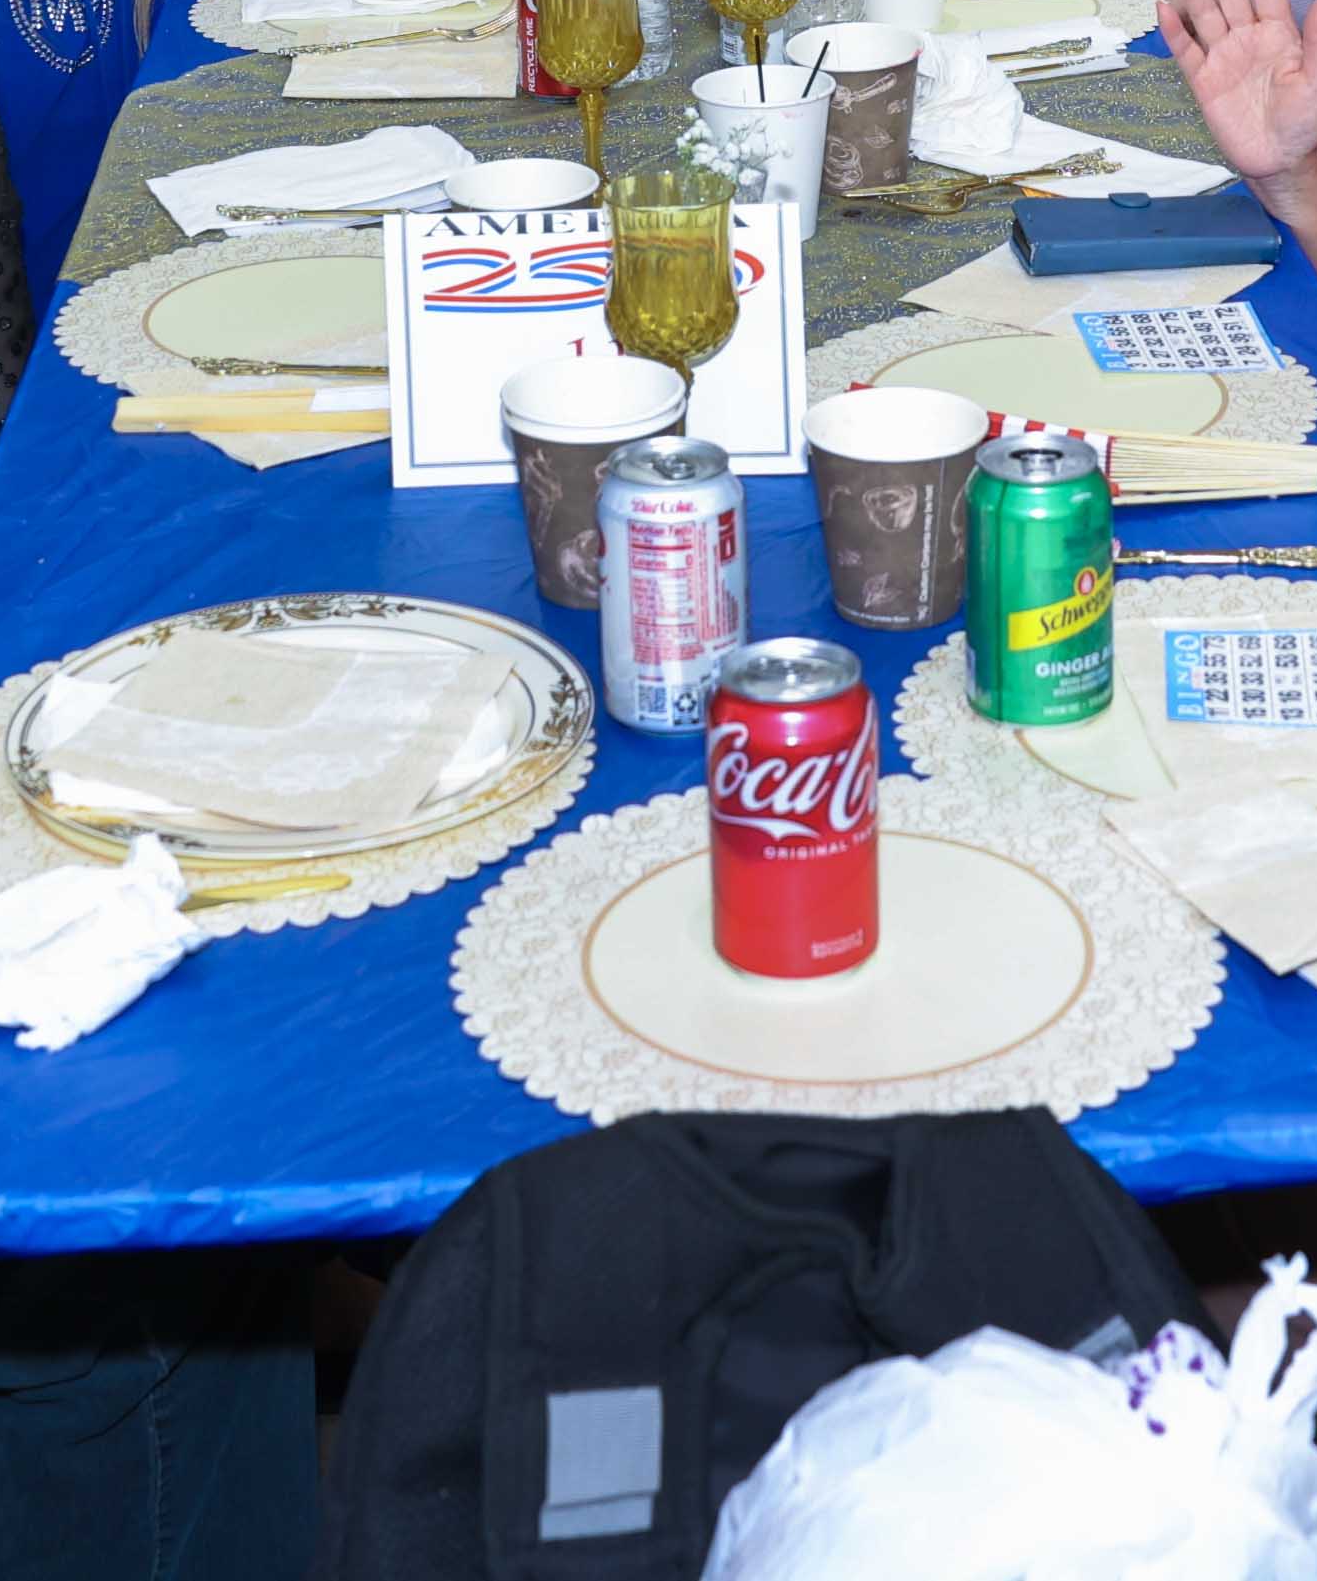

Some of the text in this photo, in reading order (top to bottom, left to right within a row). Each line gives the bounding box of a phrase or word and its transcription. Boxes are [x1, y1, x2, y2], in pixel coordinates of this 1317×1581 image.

[525, 16, 535, 37] ME
[525, 38, 536, 92] RECYCLE
[1159, 312, 1180, 322] 75
[1214, 308, 1236, 318] 72
[1203, 636, 1227, 650] 73
[1034, 651, 1100, 678] GINGER
[1205, 690, 1229, 702] 22
[763, 840, 848, 861] ORIGINAL
